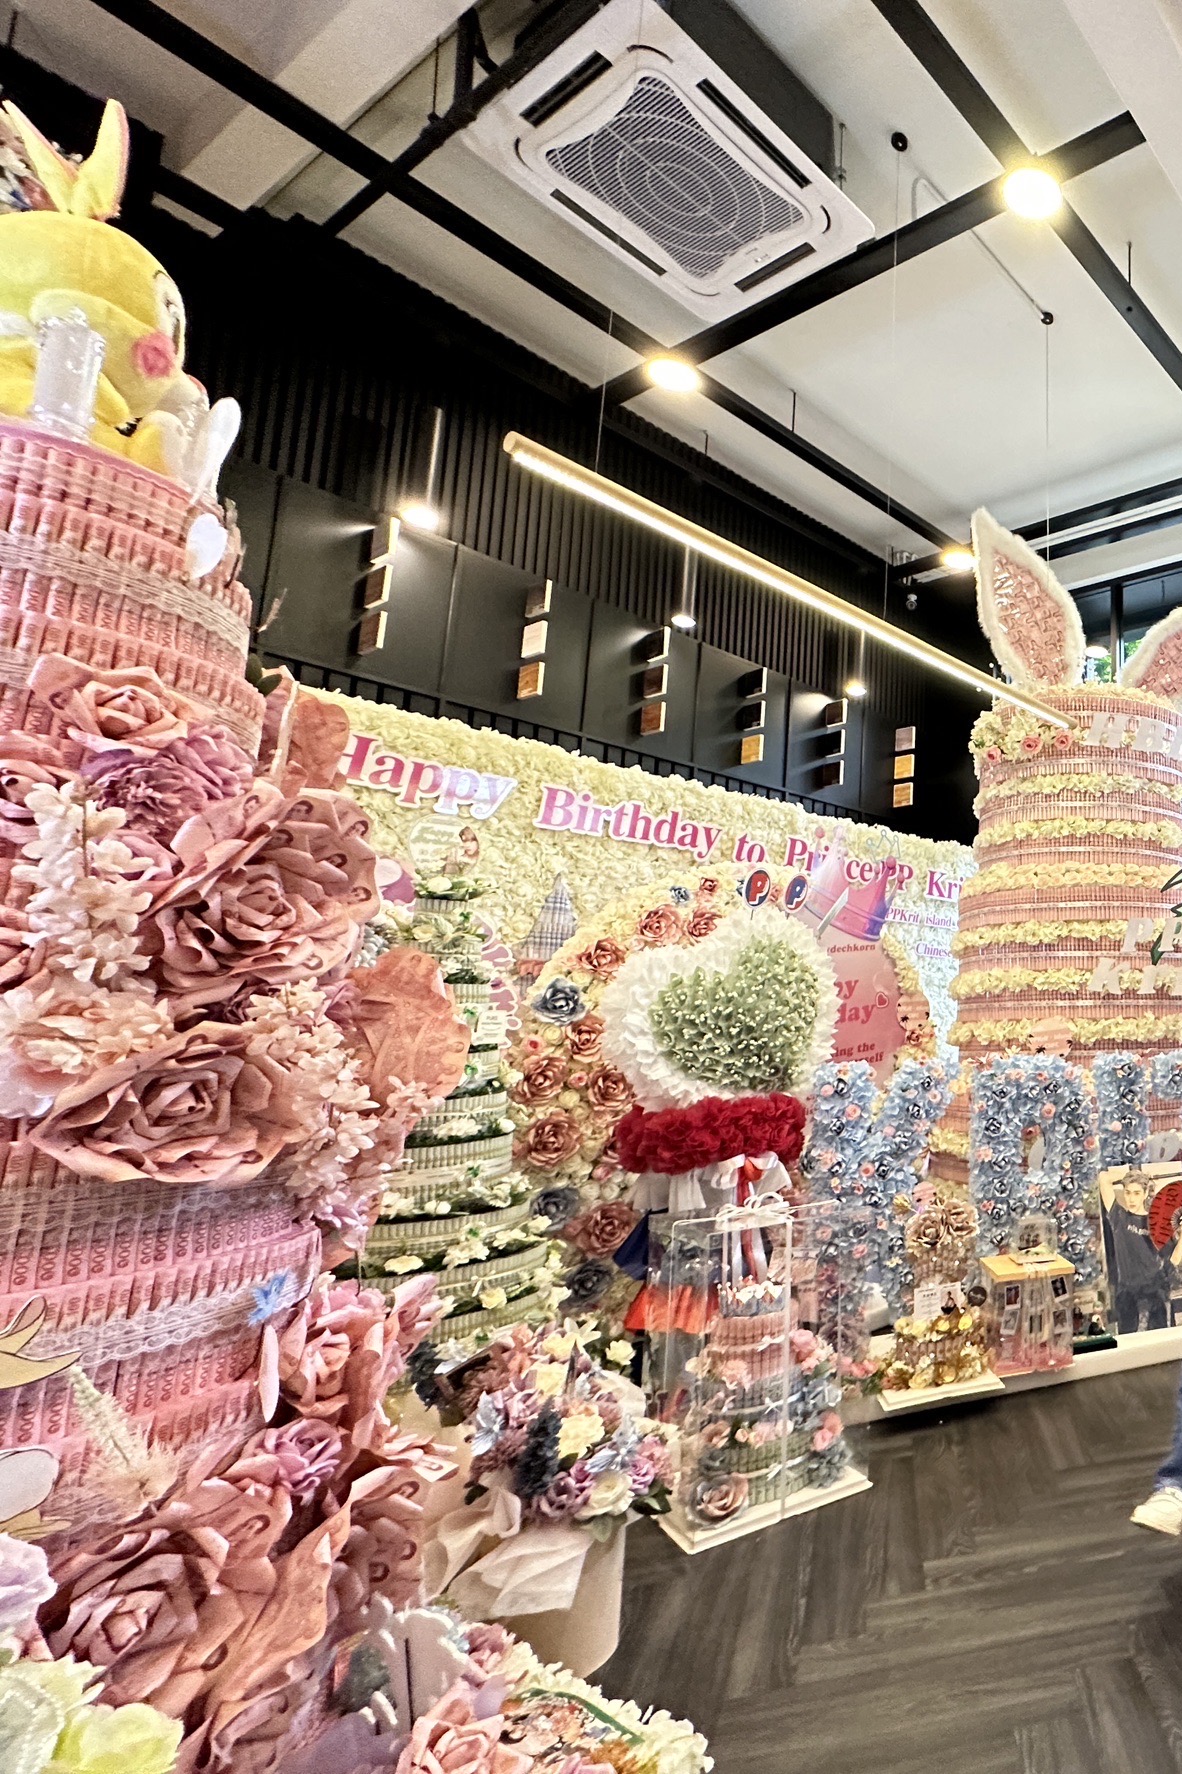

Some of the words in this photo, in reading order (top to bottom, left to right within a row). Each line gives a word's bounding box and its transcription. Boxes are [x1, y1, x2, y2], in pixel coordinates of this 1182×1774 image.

[536, 785, 723, 859] Birthday
[735, 833, 765, 863] to
[785, 836, 874, 883] Price
[857, 1042, 876, 1053] the
